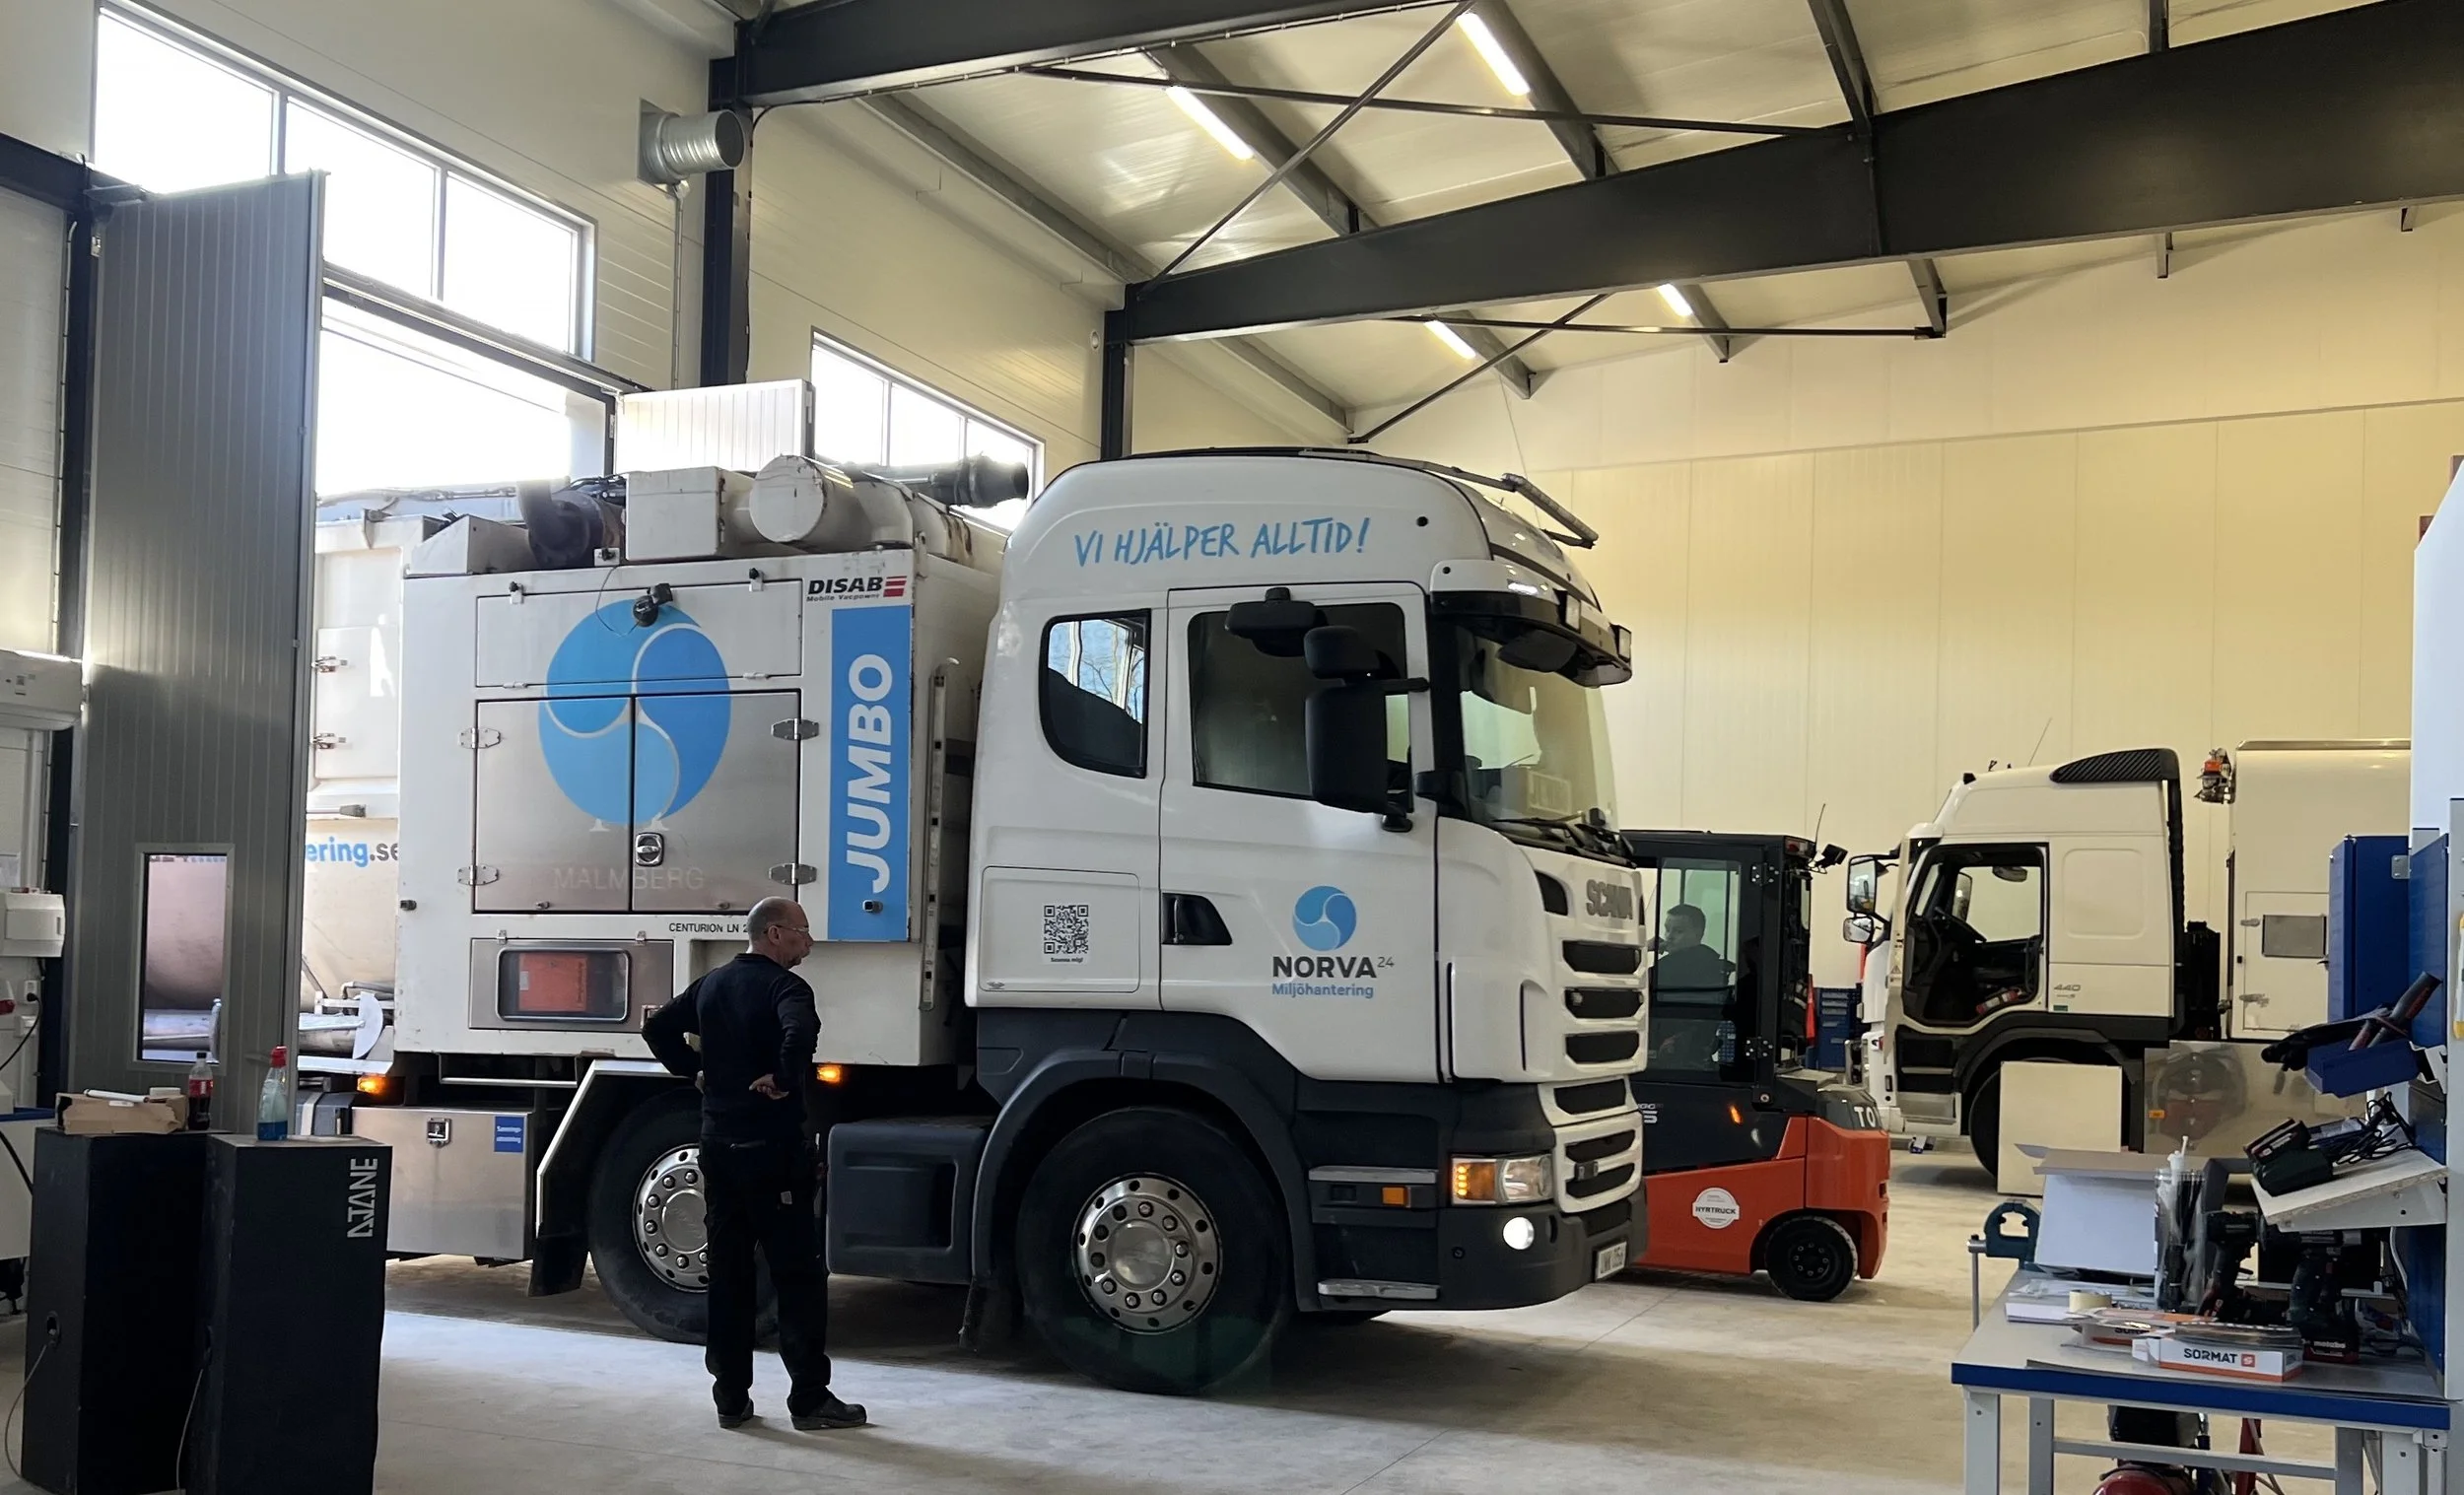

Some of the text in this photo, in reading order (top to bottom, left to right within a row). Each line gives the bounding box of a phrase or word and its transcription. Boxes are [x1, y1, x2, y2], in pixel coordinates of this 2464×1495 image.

[1074, 516, 1371, 568] VI HJÄLPER ALLTID!
[808, 576, 884, 595] DISAB
[845, 653, 893, 894] JUMBO
[553, 866, 704, 890] MALMBERG
[668, 922, 723, 933] CENTURION
[726, 923, 739, 933] LN
[1272, 955, 1378, 979] NORVA
[1271, 983, 1375, 999] Miljöhantering
[1695, 1205, 1737, 1215] HYRTRUCK
[2183, 1347, 2238, 1364] SORMAT
